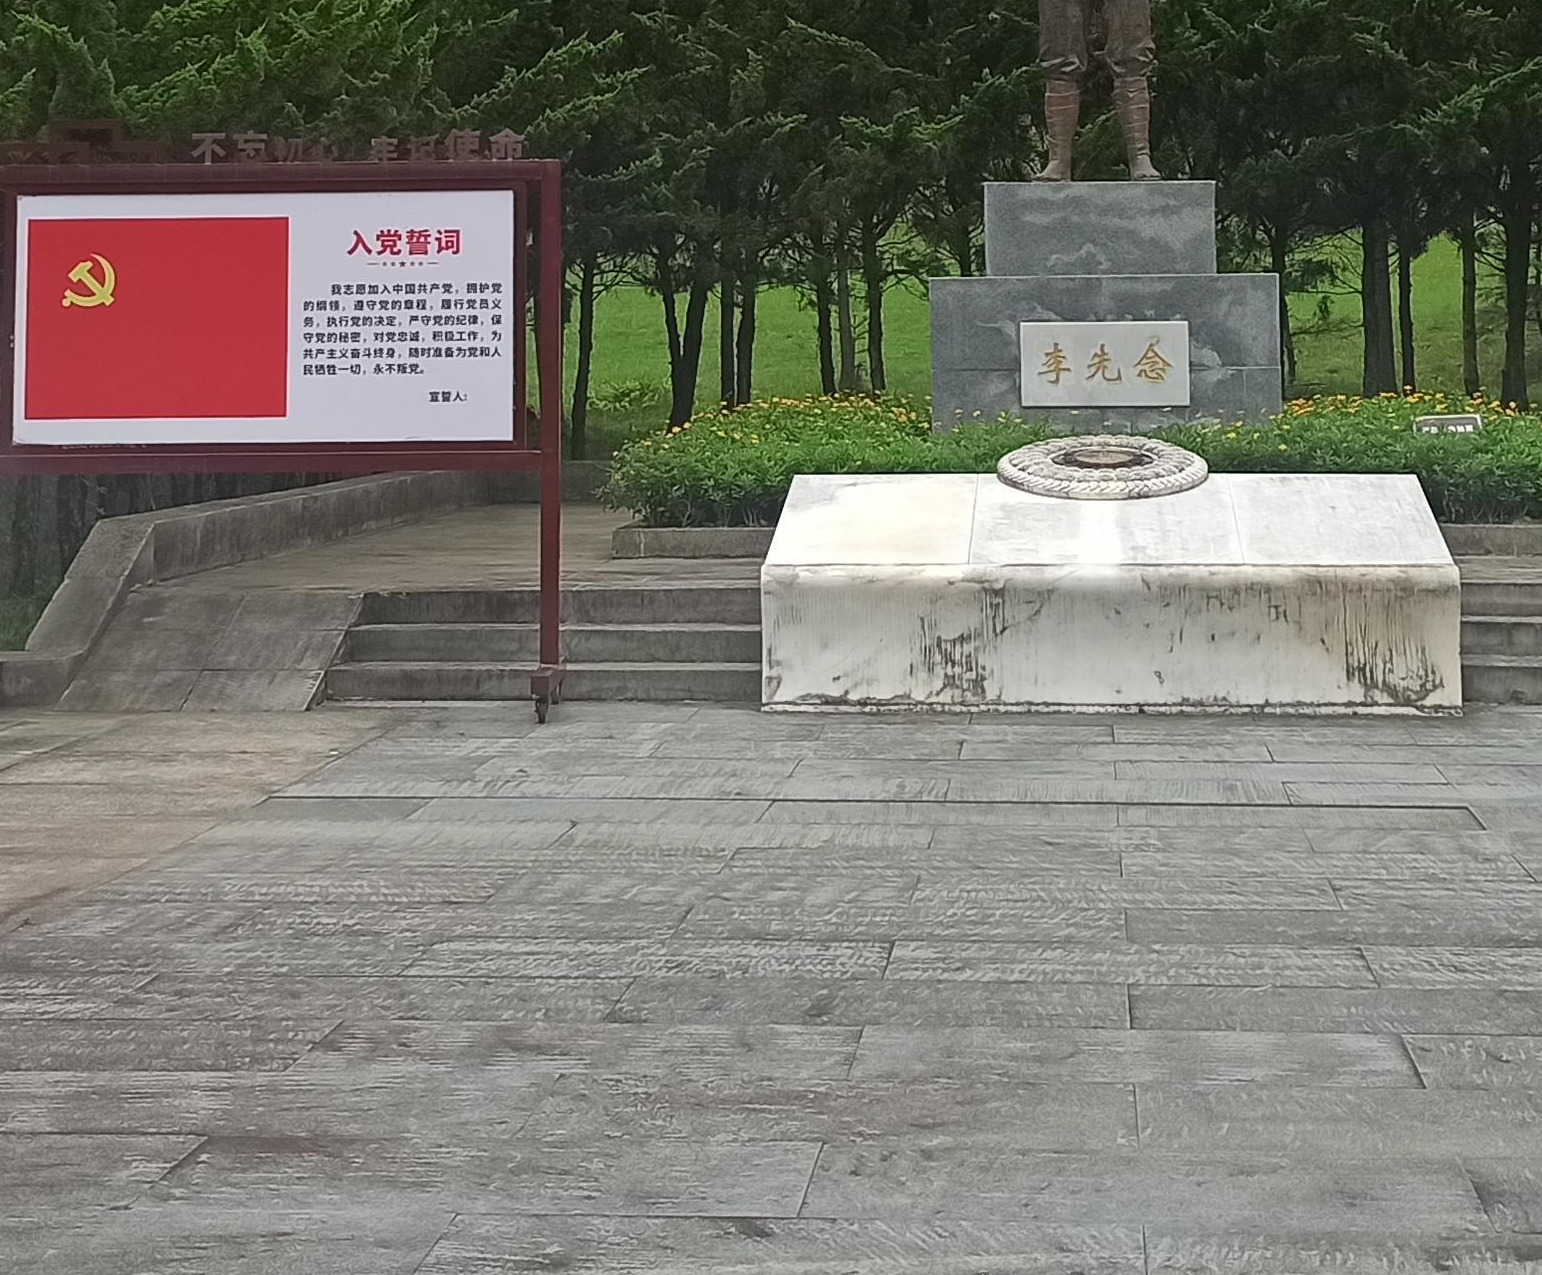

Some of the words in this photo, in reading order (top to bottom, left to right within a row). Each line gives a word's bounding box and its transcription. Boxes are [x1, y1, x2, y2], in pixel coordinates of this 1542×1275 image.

[346, 229, 462, 256] 入党誓词
[1037, 341, 1173, 385] 李先念
